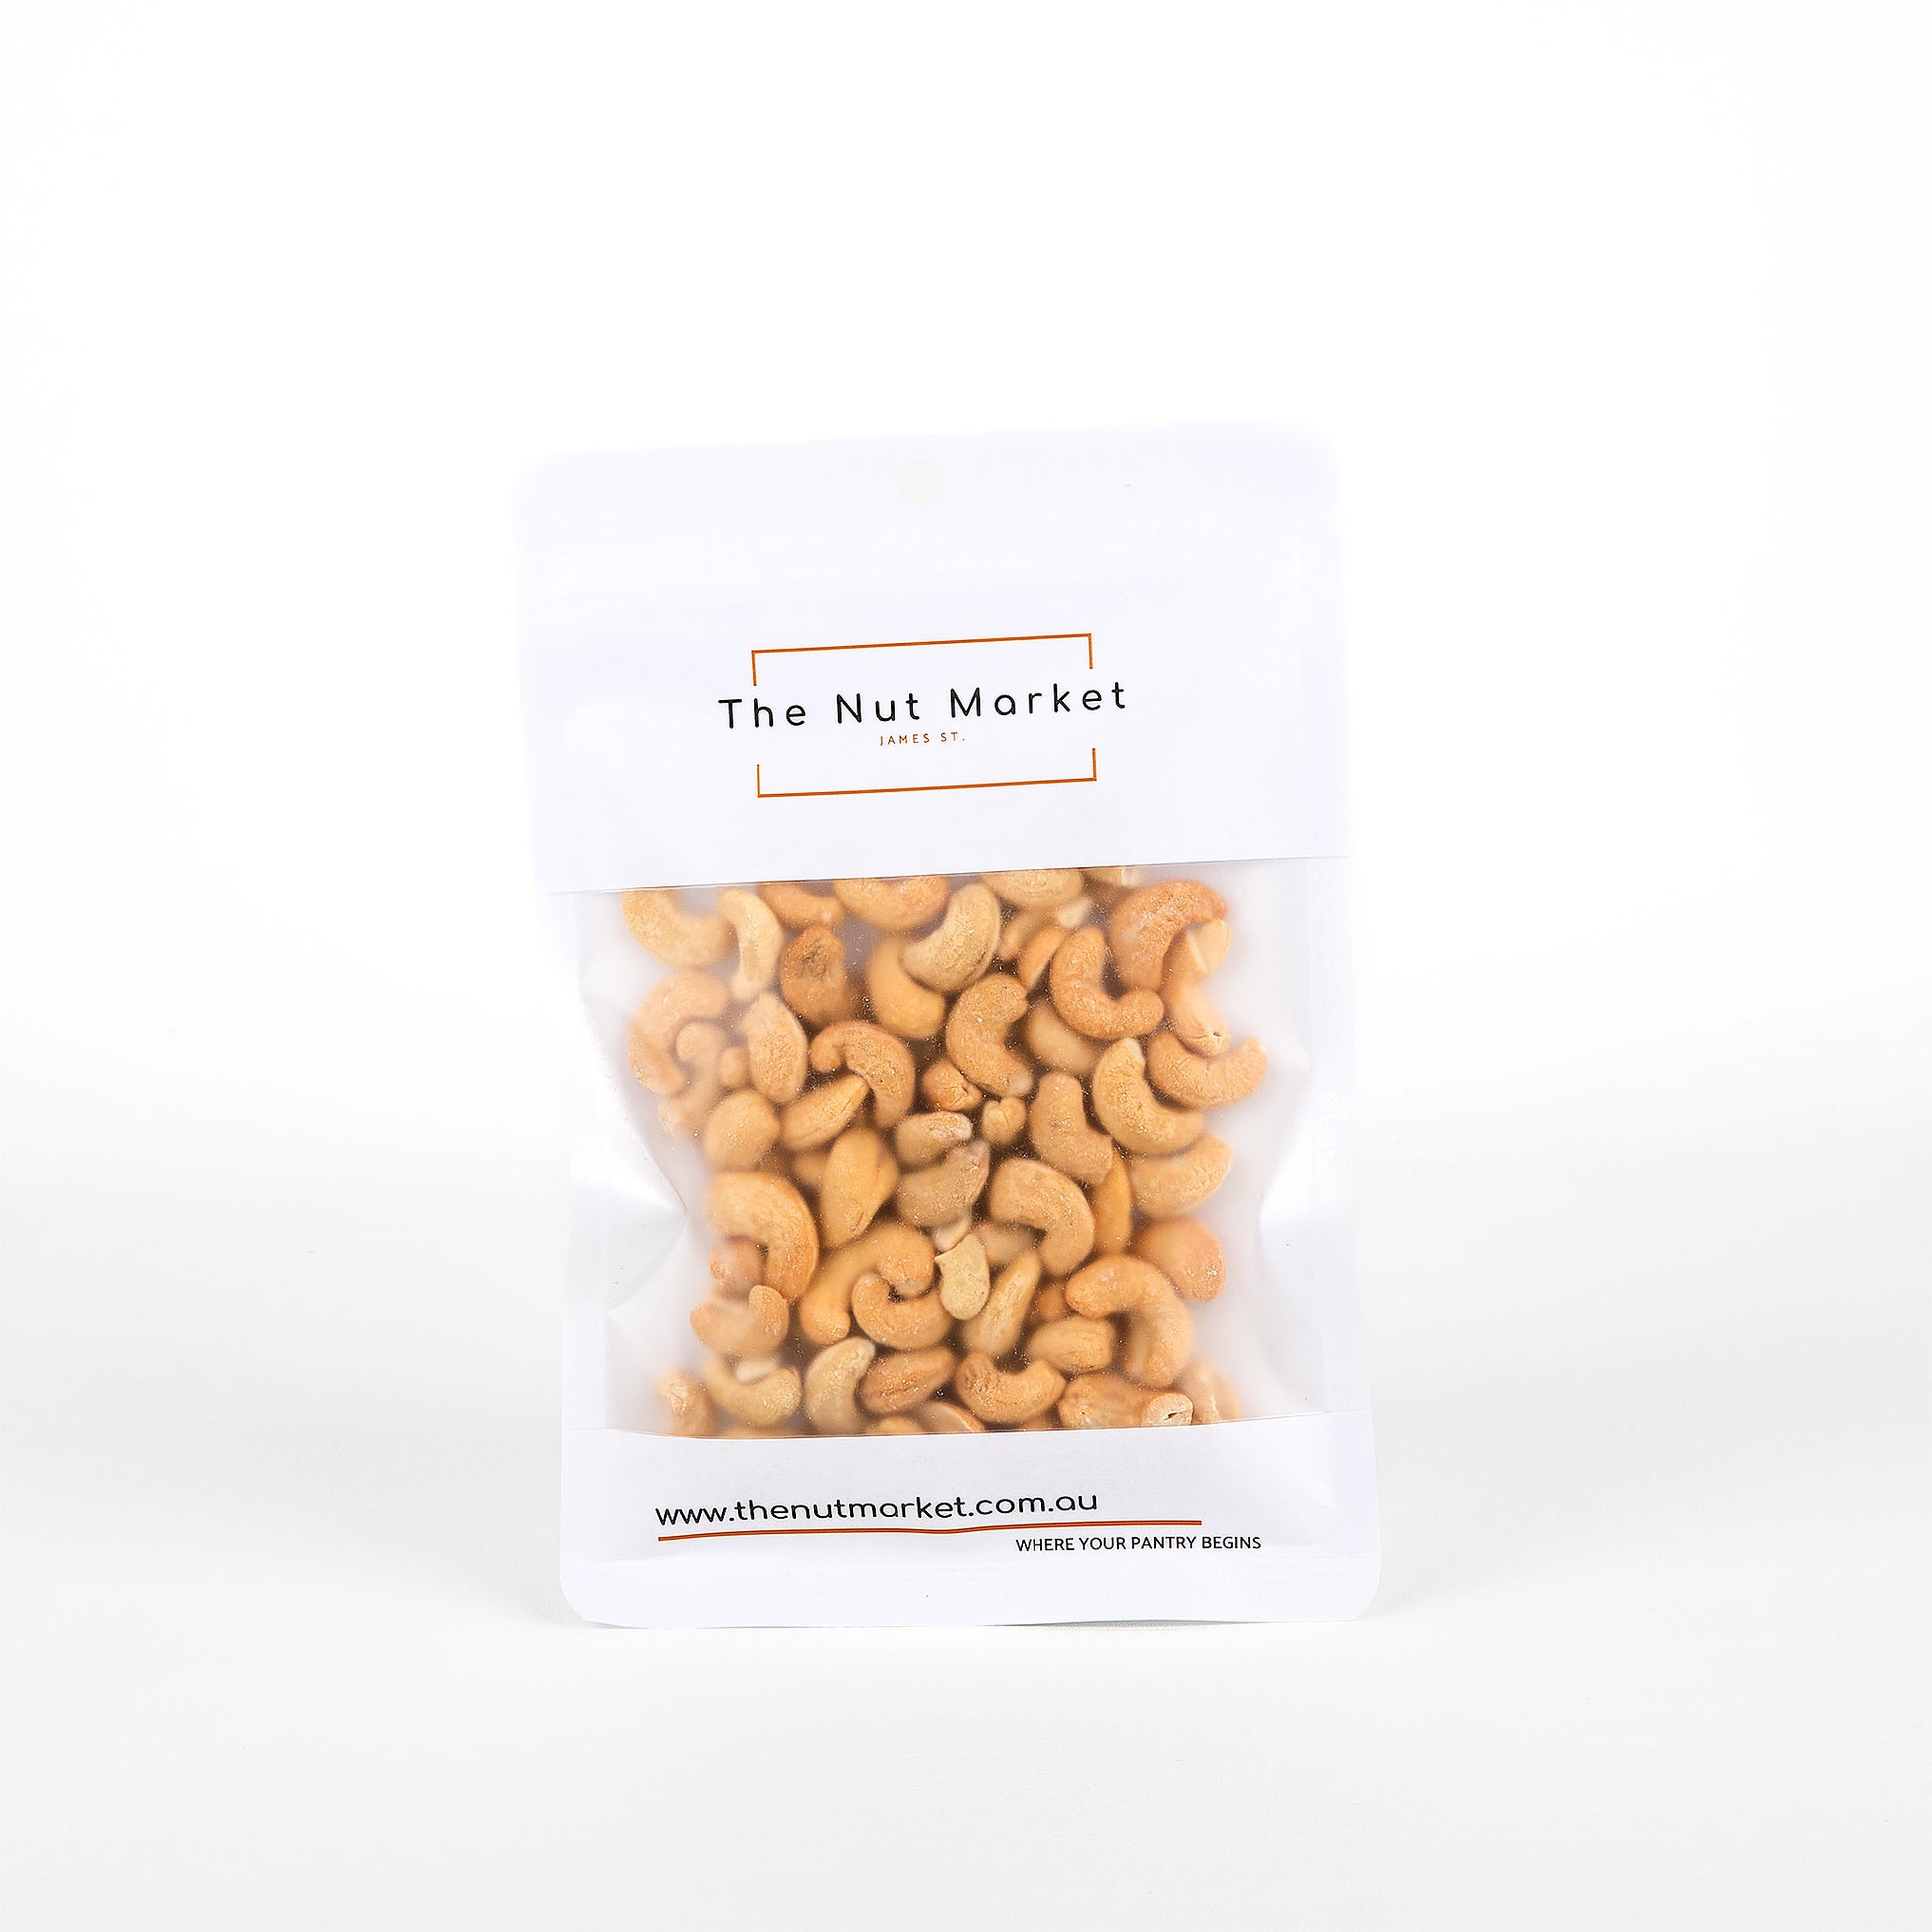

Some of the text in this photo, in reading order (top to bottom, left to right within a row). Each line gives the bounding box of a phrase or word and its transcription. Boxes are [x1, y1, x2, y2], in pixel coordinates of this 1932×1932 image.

[717, 681, 1127, 730] The Nut Market
[879, 731, 966, 747] JAMES ST.
[654, 1491, 1099, 1527] www.thenutmarket.com.au
[1015, 1536, 1262, 1552] WHERE YOUR PANTRY BEGINS
